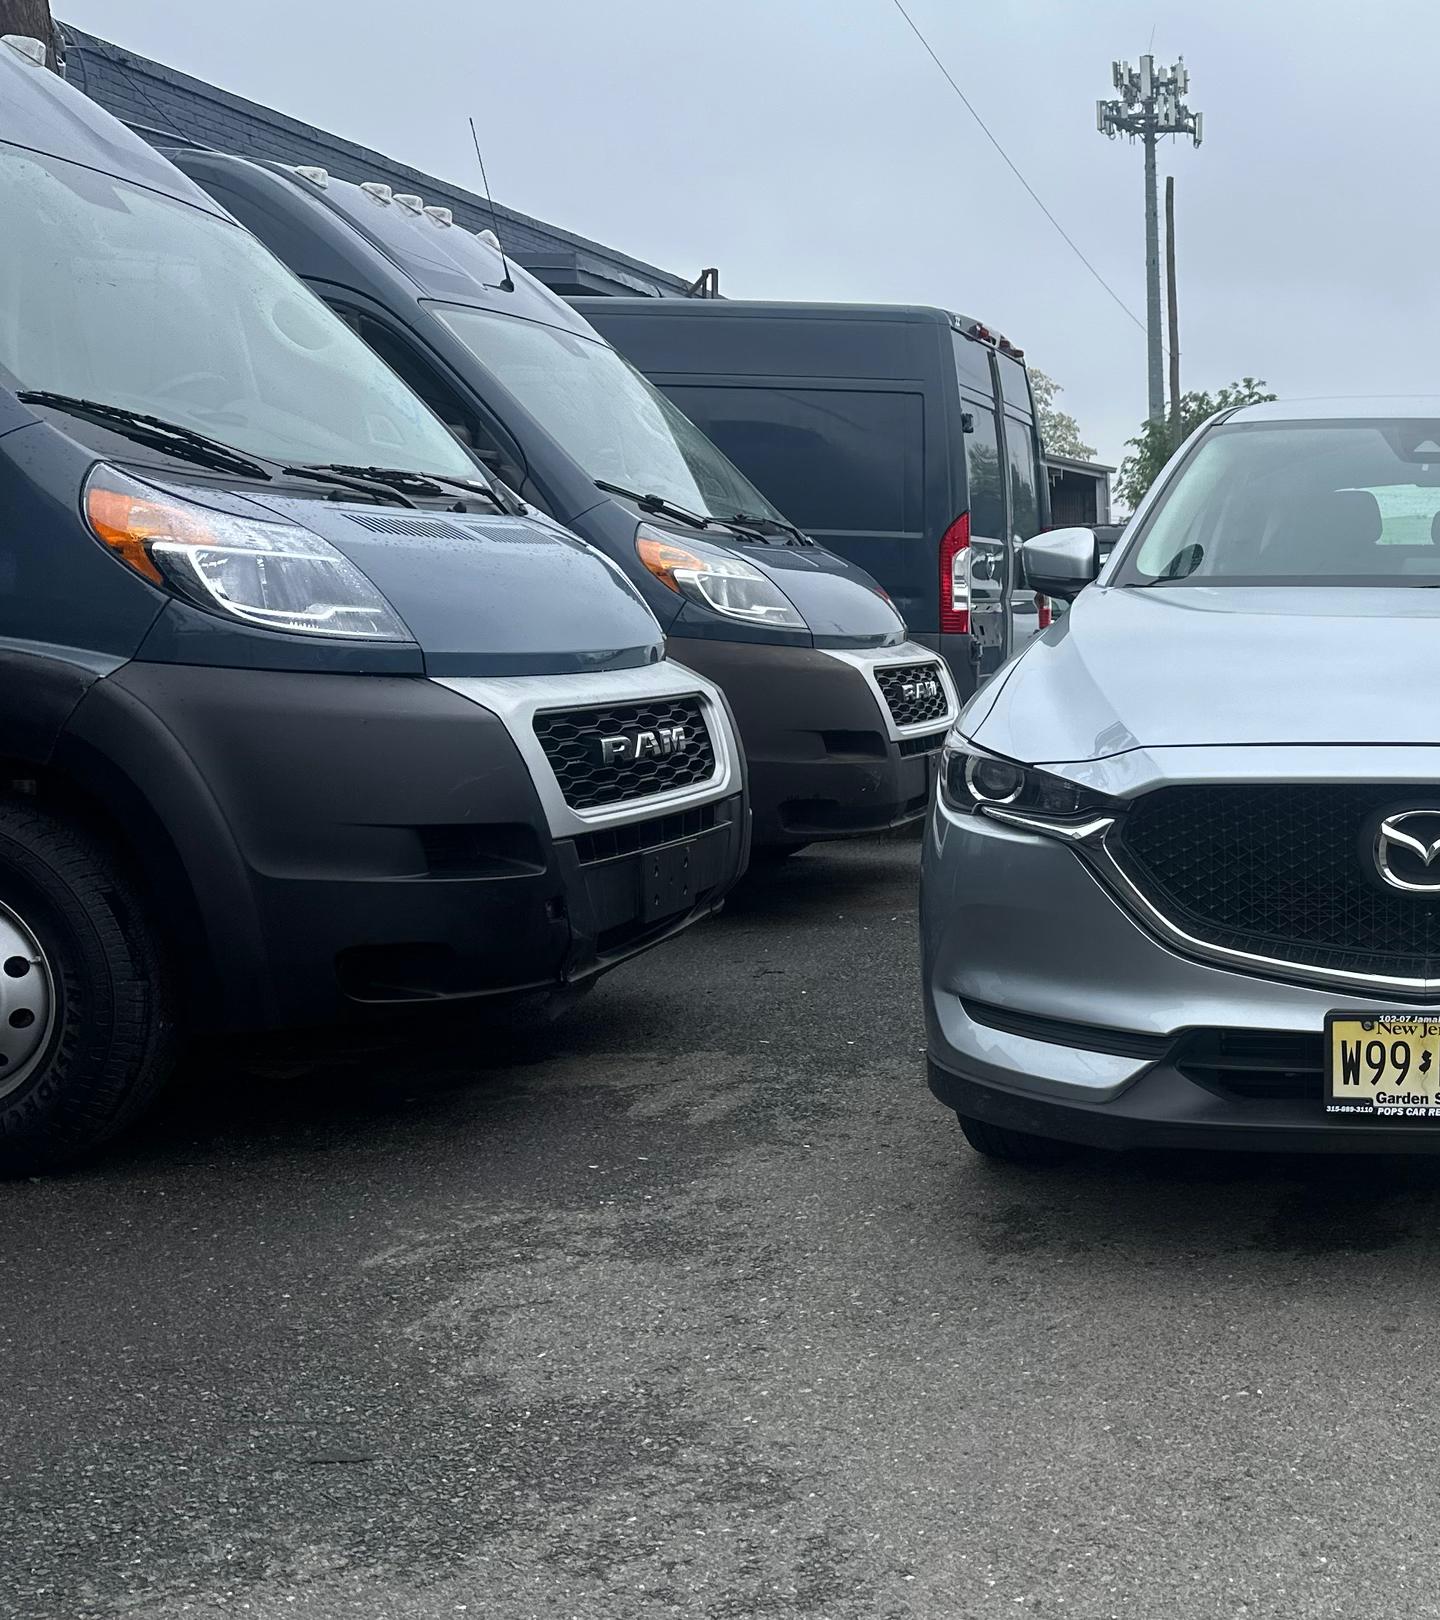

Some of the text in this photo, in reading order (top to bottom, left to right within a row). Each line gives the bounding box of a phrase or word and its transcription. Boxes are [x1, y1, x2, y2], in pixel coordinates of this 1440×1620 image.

[902, 680, 938, 700] RAM
[600, 726, 687, 764] RAM
[1379, 1015, 1411, 1023] 102-07
[1376, 1022, 1421, 1035] New
[1341, 1040, 1411, 1086] W99
[1376, 1091, 1429, 1105] Garden
[1377, 1107, 1404, 1116] POPS
[1406, 1108, 1426, 1116] CAR
